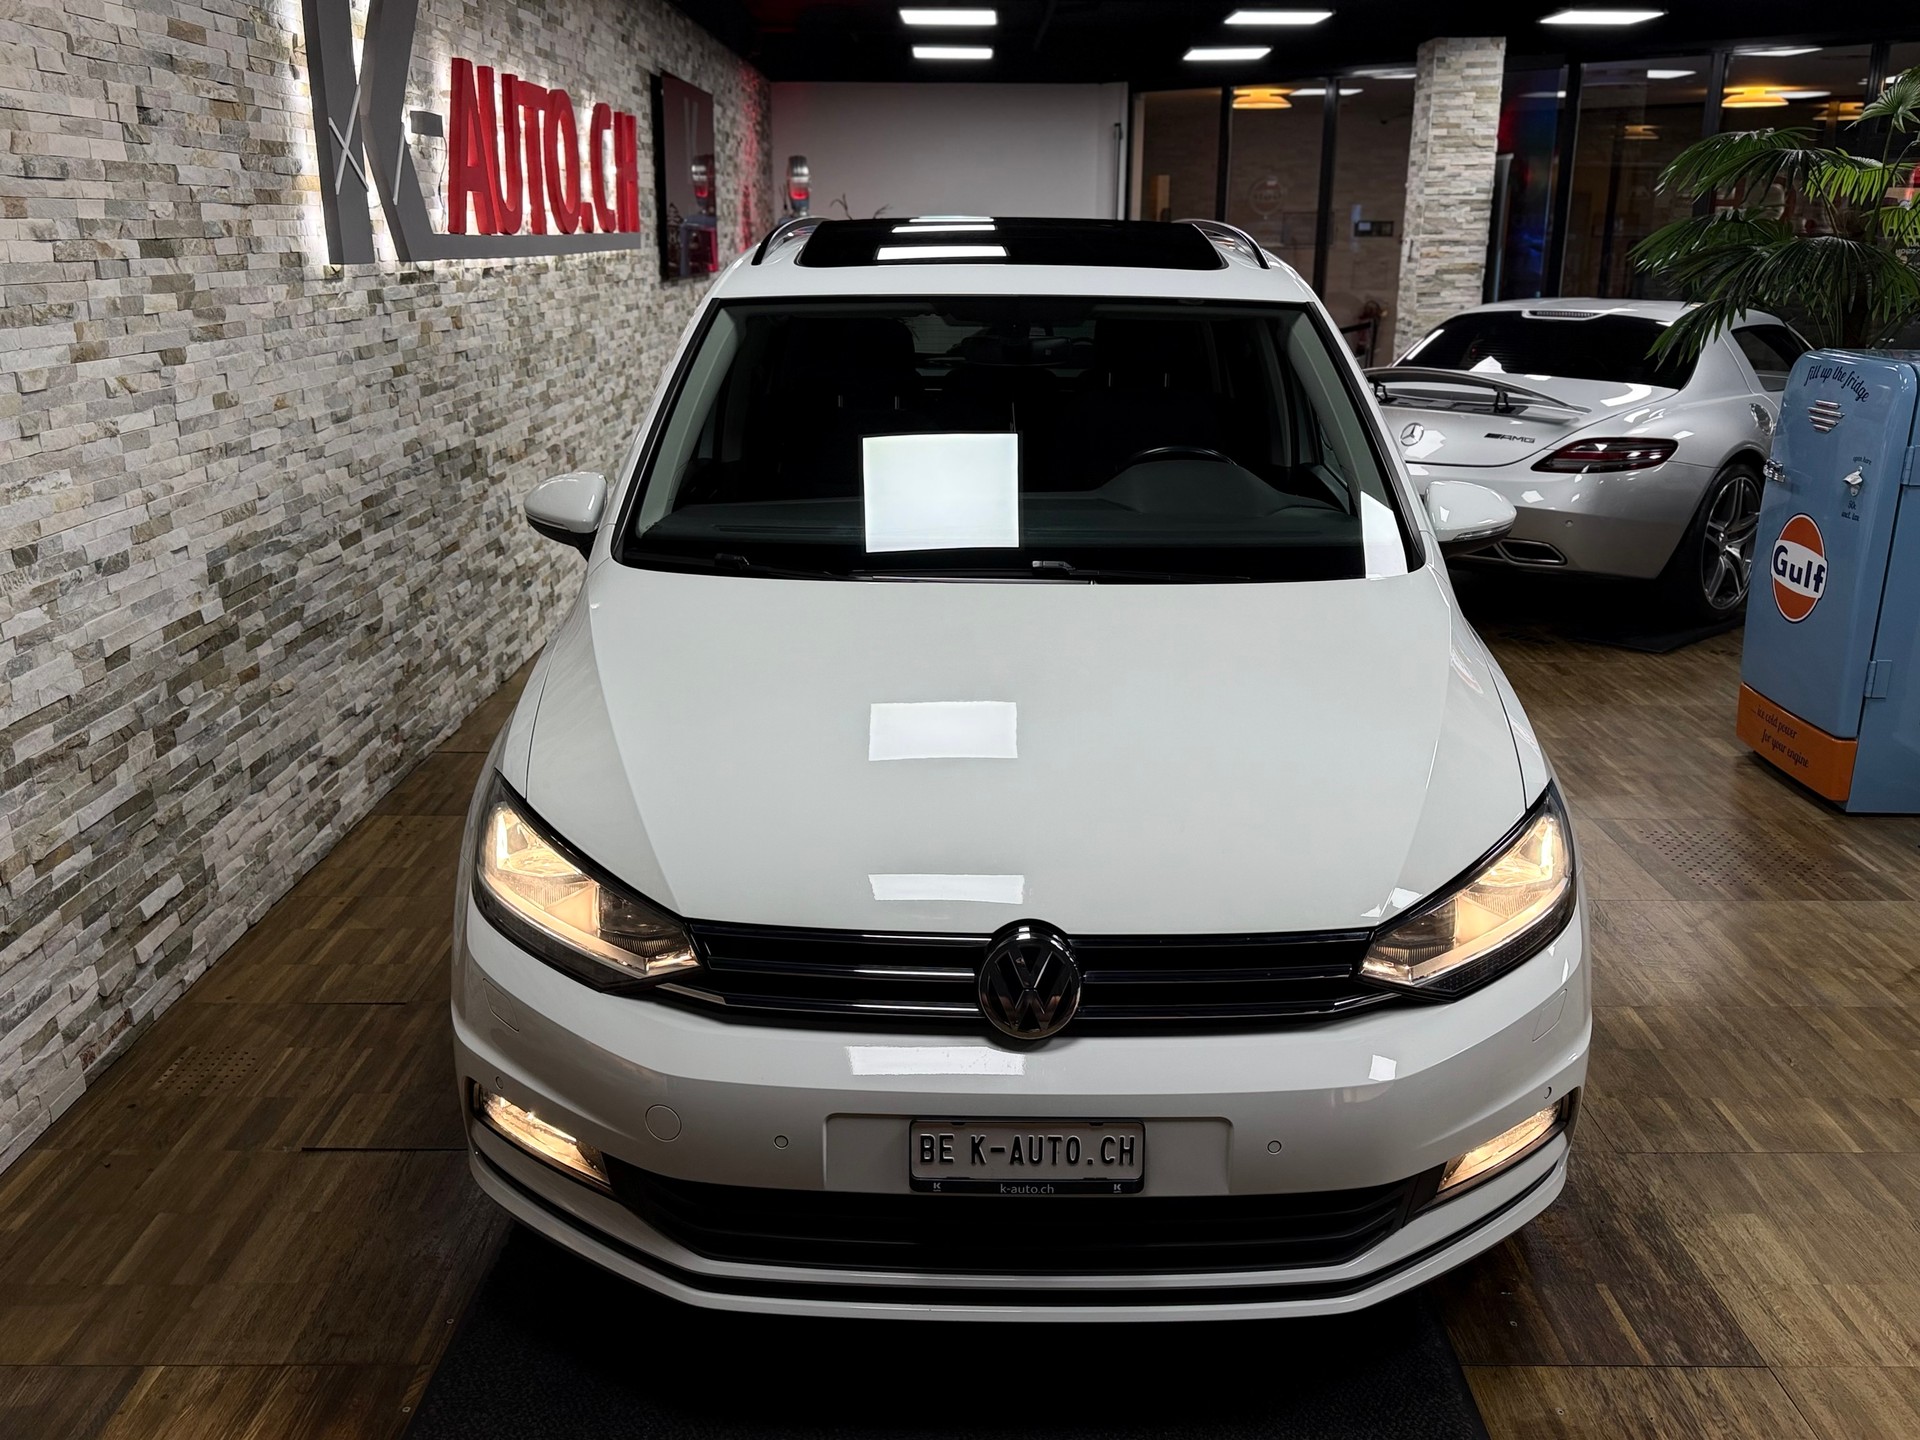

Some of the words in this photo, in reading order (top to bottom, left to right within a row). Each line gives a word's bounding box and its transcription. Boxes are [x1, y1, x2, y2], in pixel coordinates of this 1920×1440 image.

[1803, 365, 1821, 387] fill
[1820, 367, 1833, 383] up
[1832, 366, 1847, 382] the
[1841, 370, 1870, 402] fridge
[1499, 434, 1536, 444] AMG
[1773, 544, 1826, 593] Gulf
[1765, 714, 1779, 728] cold
[1778, 721, 1798, 739] power
[1761, 729, 1771, 743] for
[1771, 738, 1786, 753] your
[1786, 748, 1809, 768] engine
[919, 1133, 955, 1164] BE
[970, 1134, 1135, 1166] K-AUTO.CH
[1000, 1183, 1055, 1194] k-auto.ch
